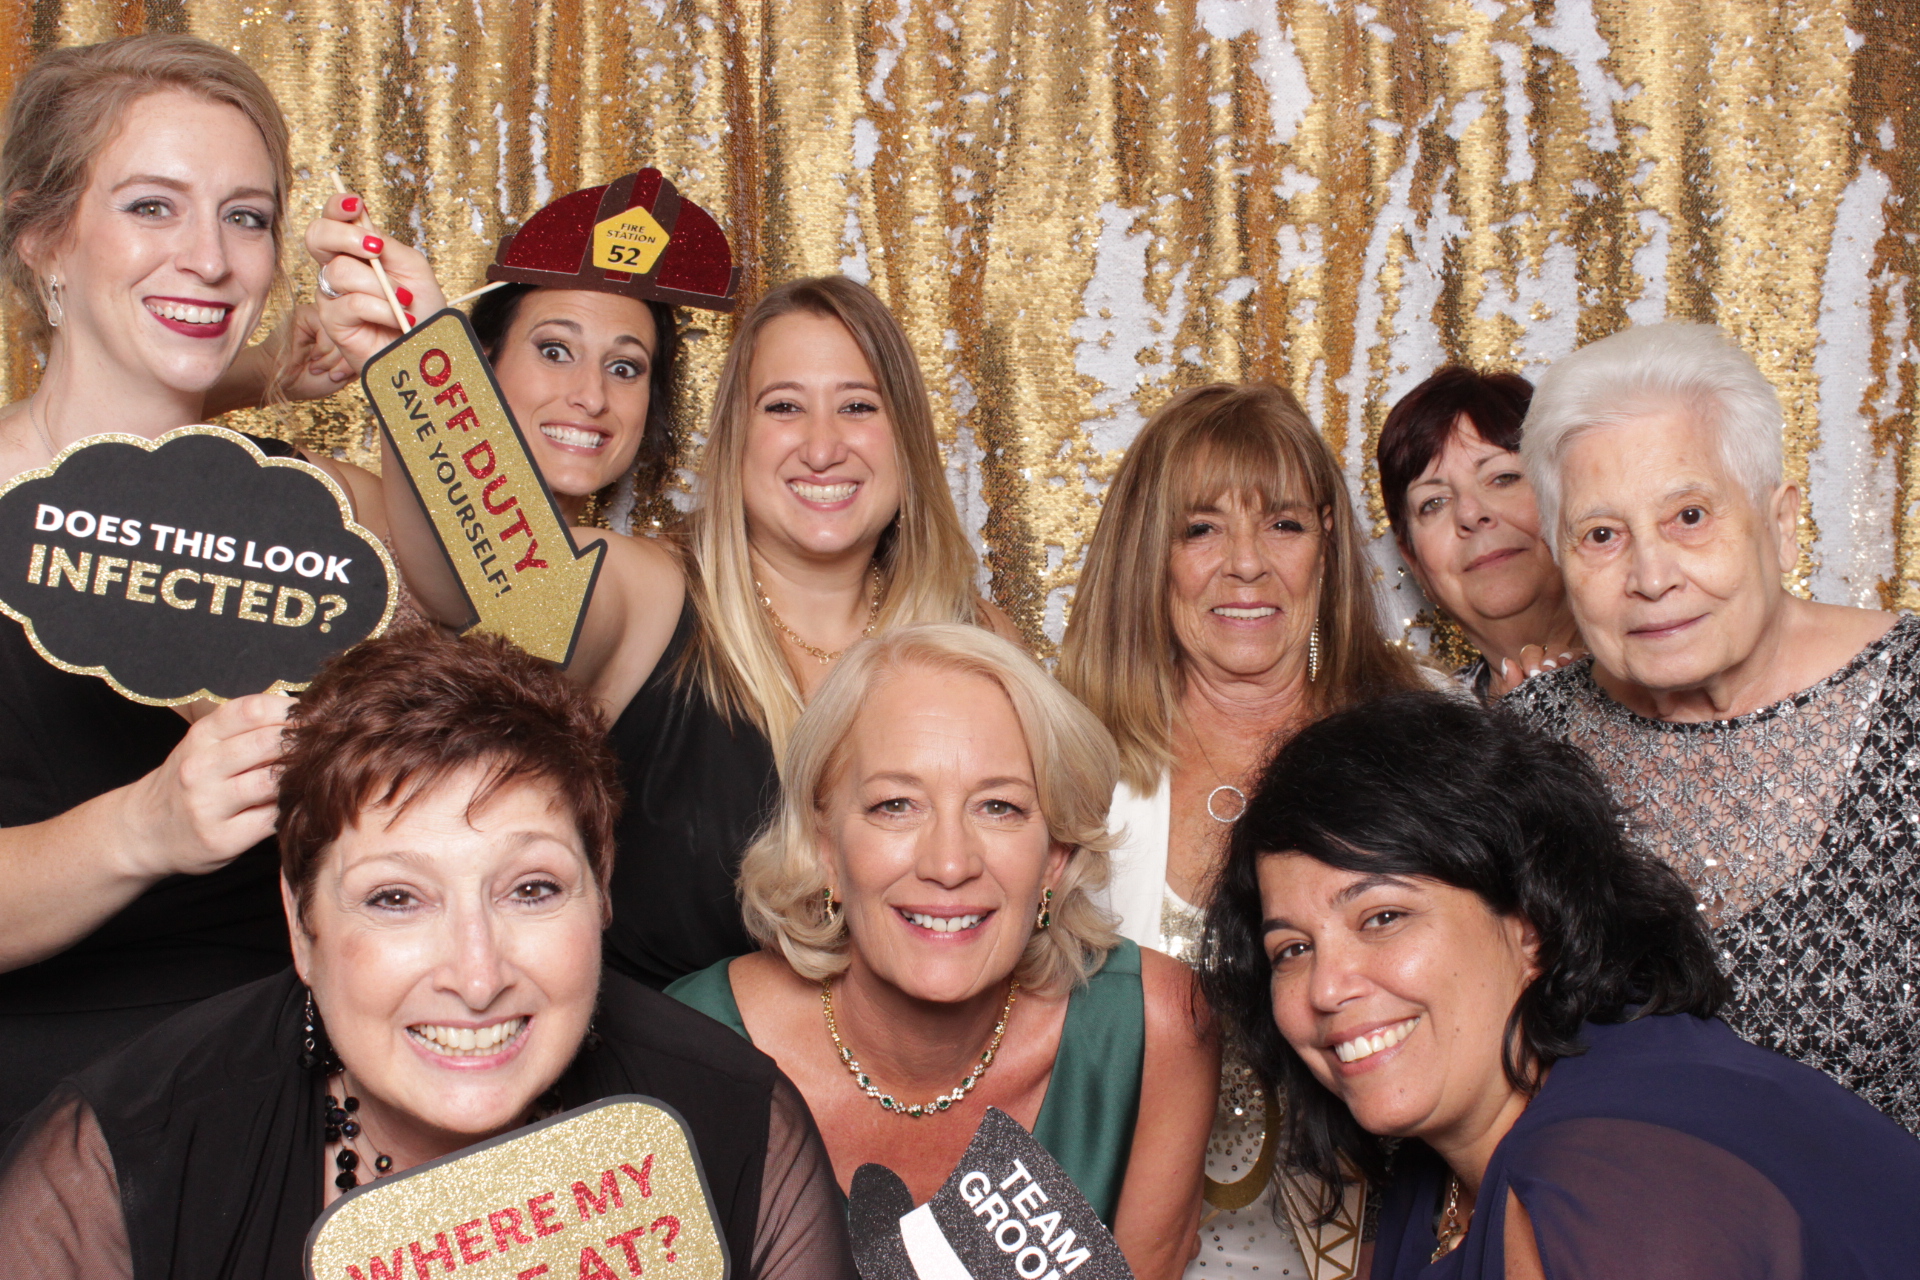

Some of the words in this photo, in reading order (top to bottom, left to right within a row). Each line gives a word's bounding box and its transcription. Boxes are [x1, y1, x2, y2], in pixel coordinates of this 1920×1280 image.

[607, 230, 656, 244] STATION
[608, 244, 641, 266] 52
[621, 223, 645, 233] FIRE
[391, 369, 436, 442] SAVE
[429, 441, 512, 598] YOURSELF!
[419, 348, 480, 433] OFF
[461, 439, 549, 574] DUTY
[35, 504, 141, 546] DOES
[150, 523, 236, 563] THIS
[243, 541, 352, 584] LOOK
[27, 543, 348, 633] INFECTED?
[570, 1153, 655, 1222] MY
[959, 1171, 1061, 1280] GROO
[1000, 1158, 1091, 1274] TEAM
[578, 1215, 681, 1280] AT?
